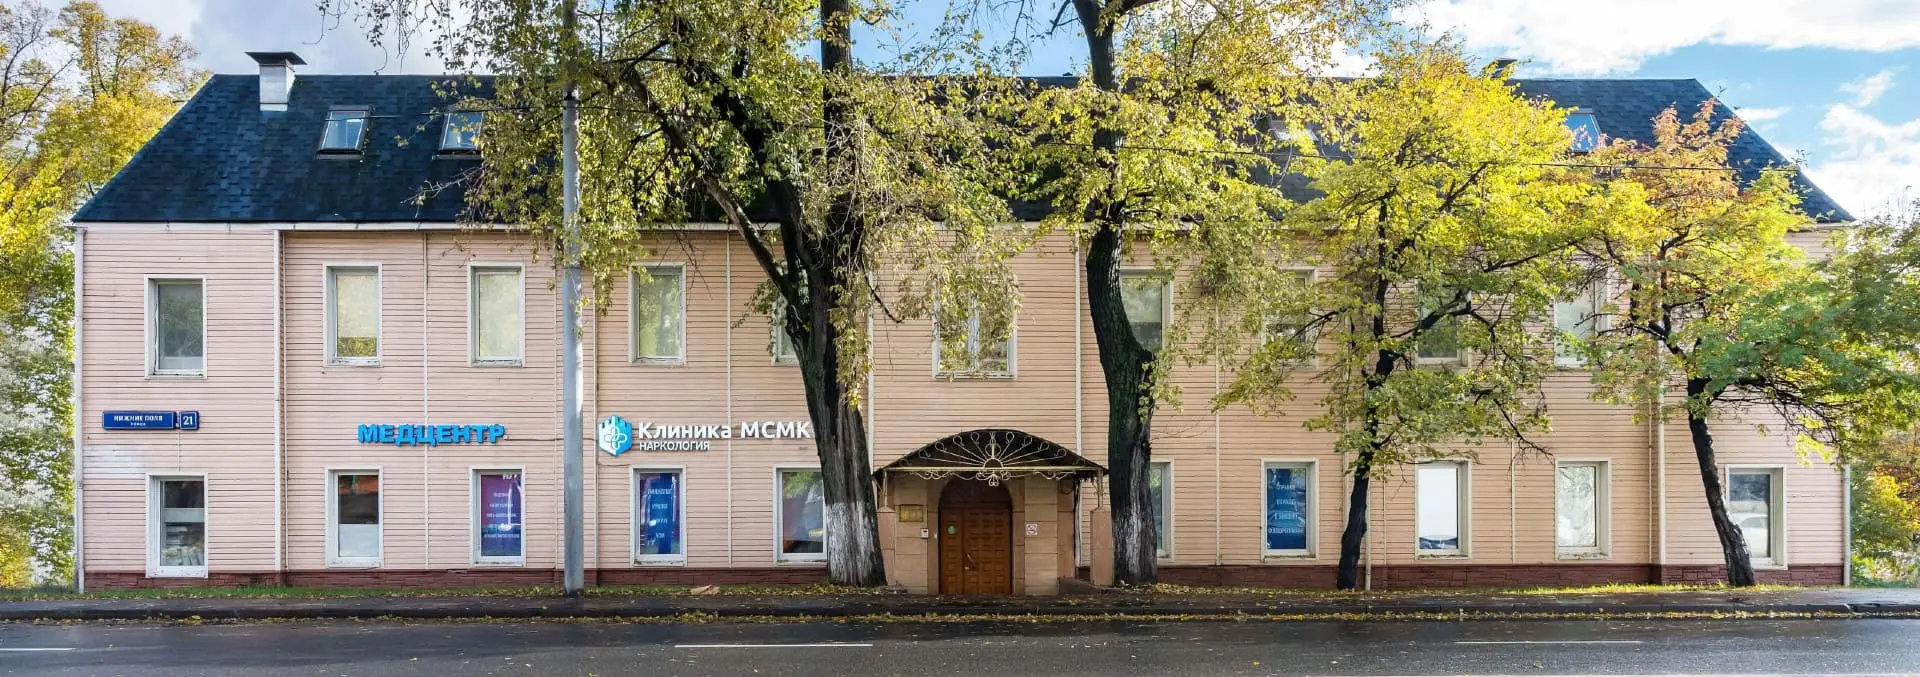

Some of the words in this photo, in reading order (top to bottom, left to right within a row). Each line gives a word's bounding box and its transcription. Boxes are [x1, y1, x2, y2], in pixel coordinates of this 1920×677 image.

[183, 415, 193, 426] 21
[357, 423, 505, 447] МЕДЦЕНТР
[638, 421, 731, 440] Клиника
[740, 420, 811, 440] МСМК
[639, 441, 710, 451] НАРКОЛОГИЯ
